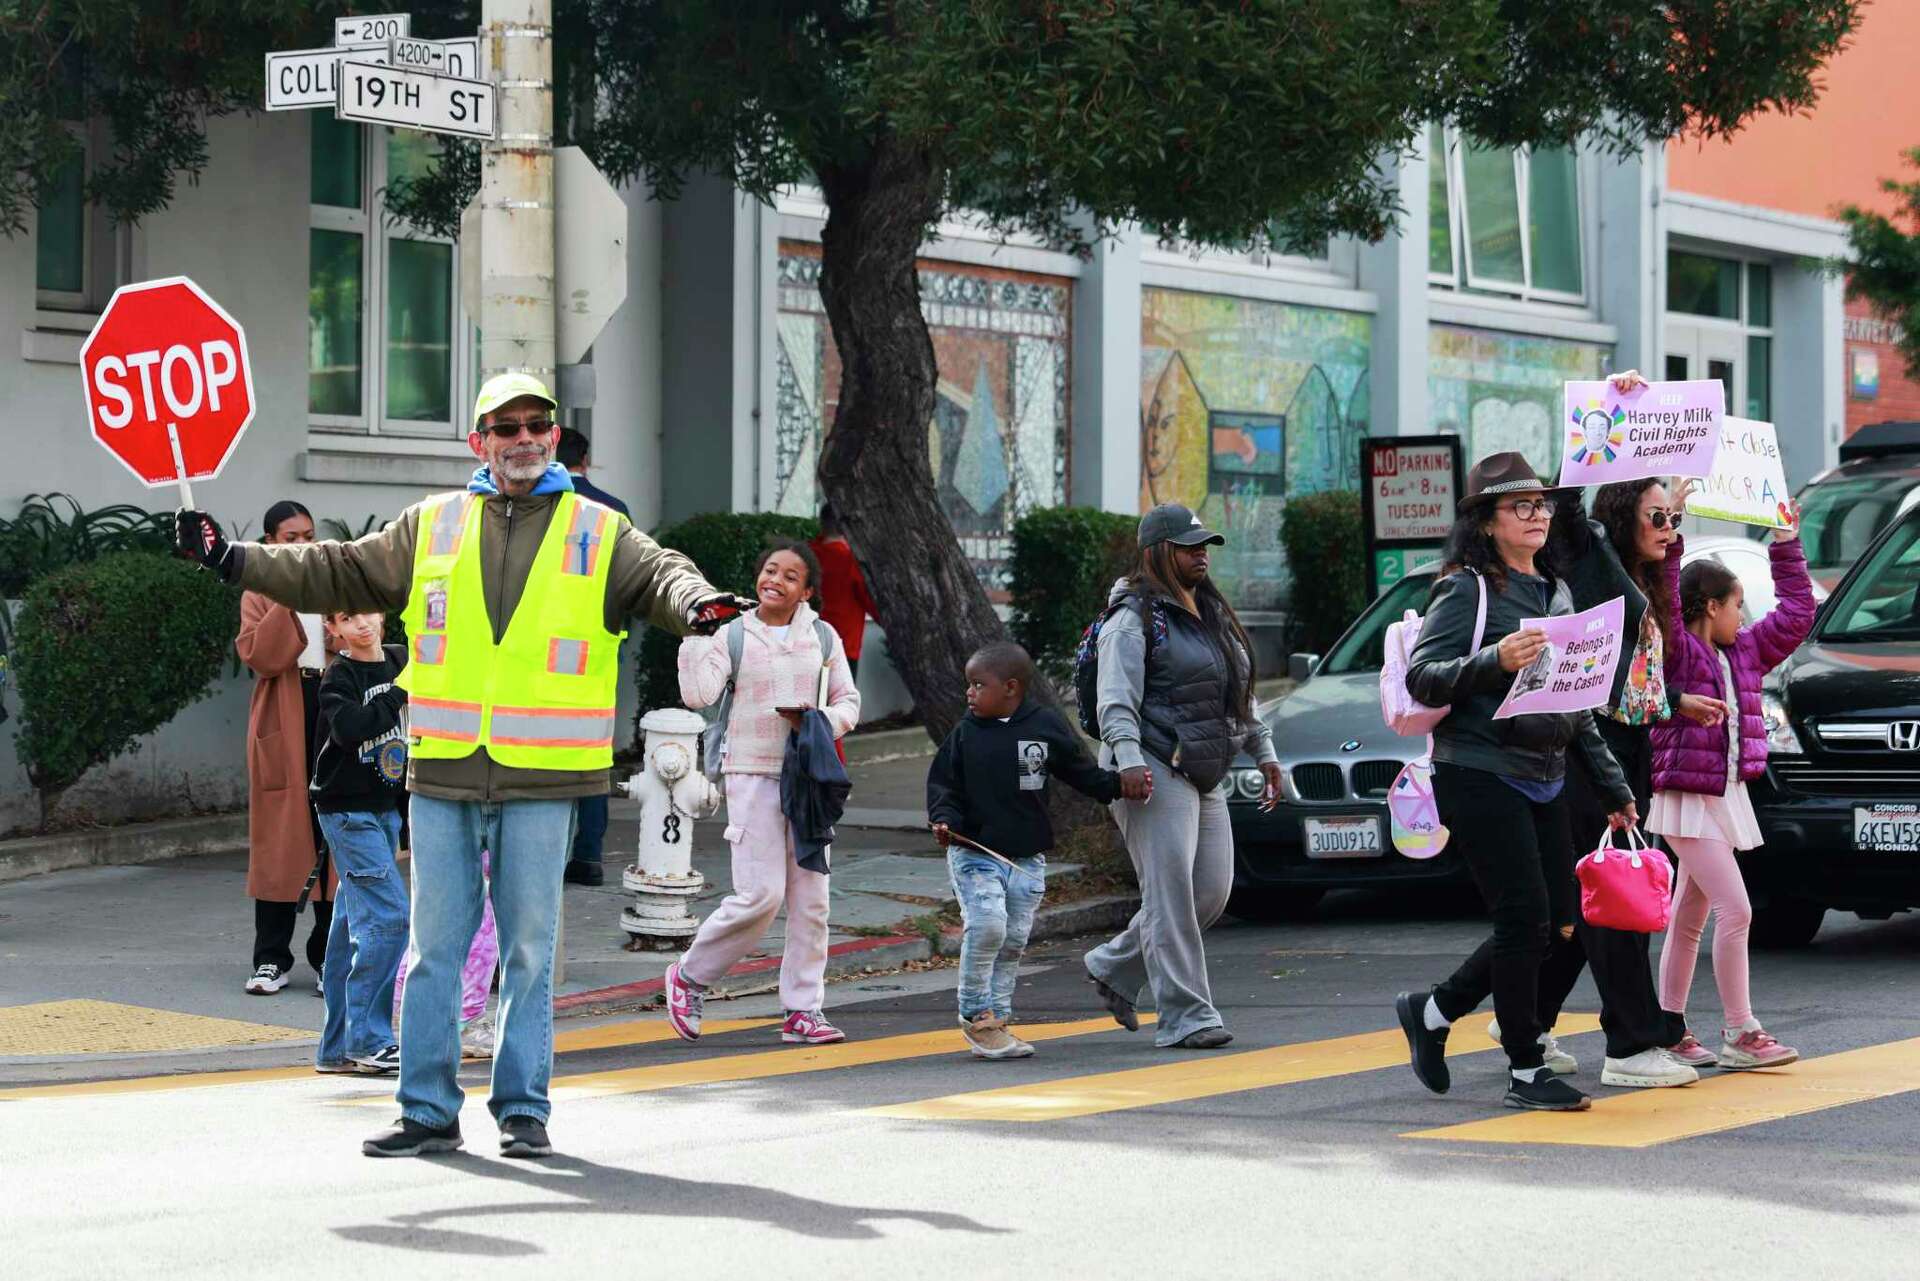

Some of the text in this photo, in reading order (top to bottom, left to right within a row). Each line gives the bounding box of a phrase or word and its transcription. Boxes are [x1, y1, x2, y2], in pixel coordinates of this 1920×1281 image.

[362, 20, 398, 41] 200
[397, 42, 431, 65] 4200
[355, 75, 485, 123] 19TH ST
[94, 340, 237, 429] STOP
[1628, 407, 1713, 427] Harvey Milk
[1629, 425, 1707, 443] Civil Rights
[1741, 431, 1777, 458] Close
[1633, 441, 1695, 458] Academy
[1373, 450, 1451, 476] NO PARKING
[1386, 503, 1442, 520] TUESDAY
[1383, 556, 1399, 579] 2
[1565, 631, 1614, 656] Belongs in
[1558, 650, 1612, 674] the of
[1551, 673, 1605, 693] the Castro
[1874, 804, 1917, 812] CONCORD
[662, 814, 681, 844] 8
[1312, 831, 1377, 851] 3UDU912
[1874, 843, 1918, 851] HONDA
